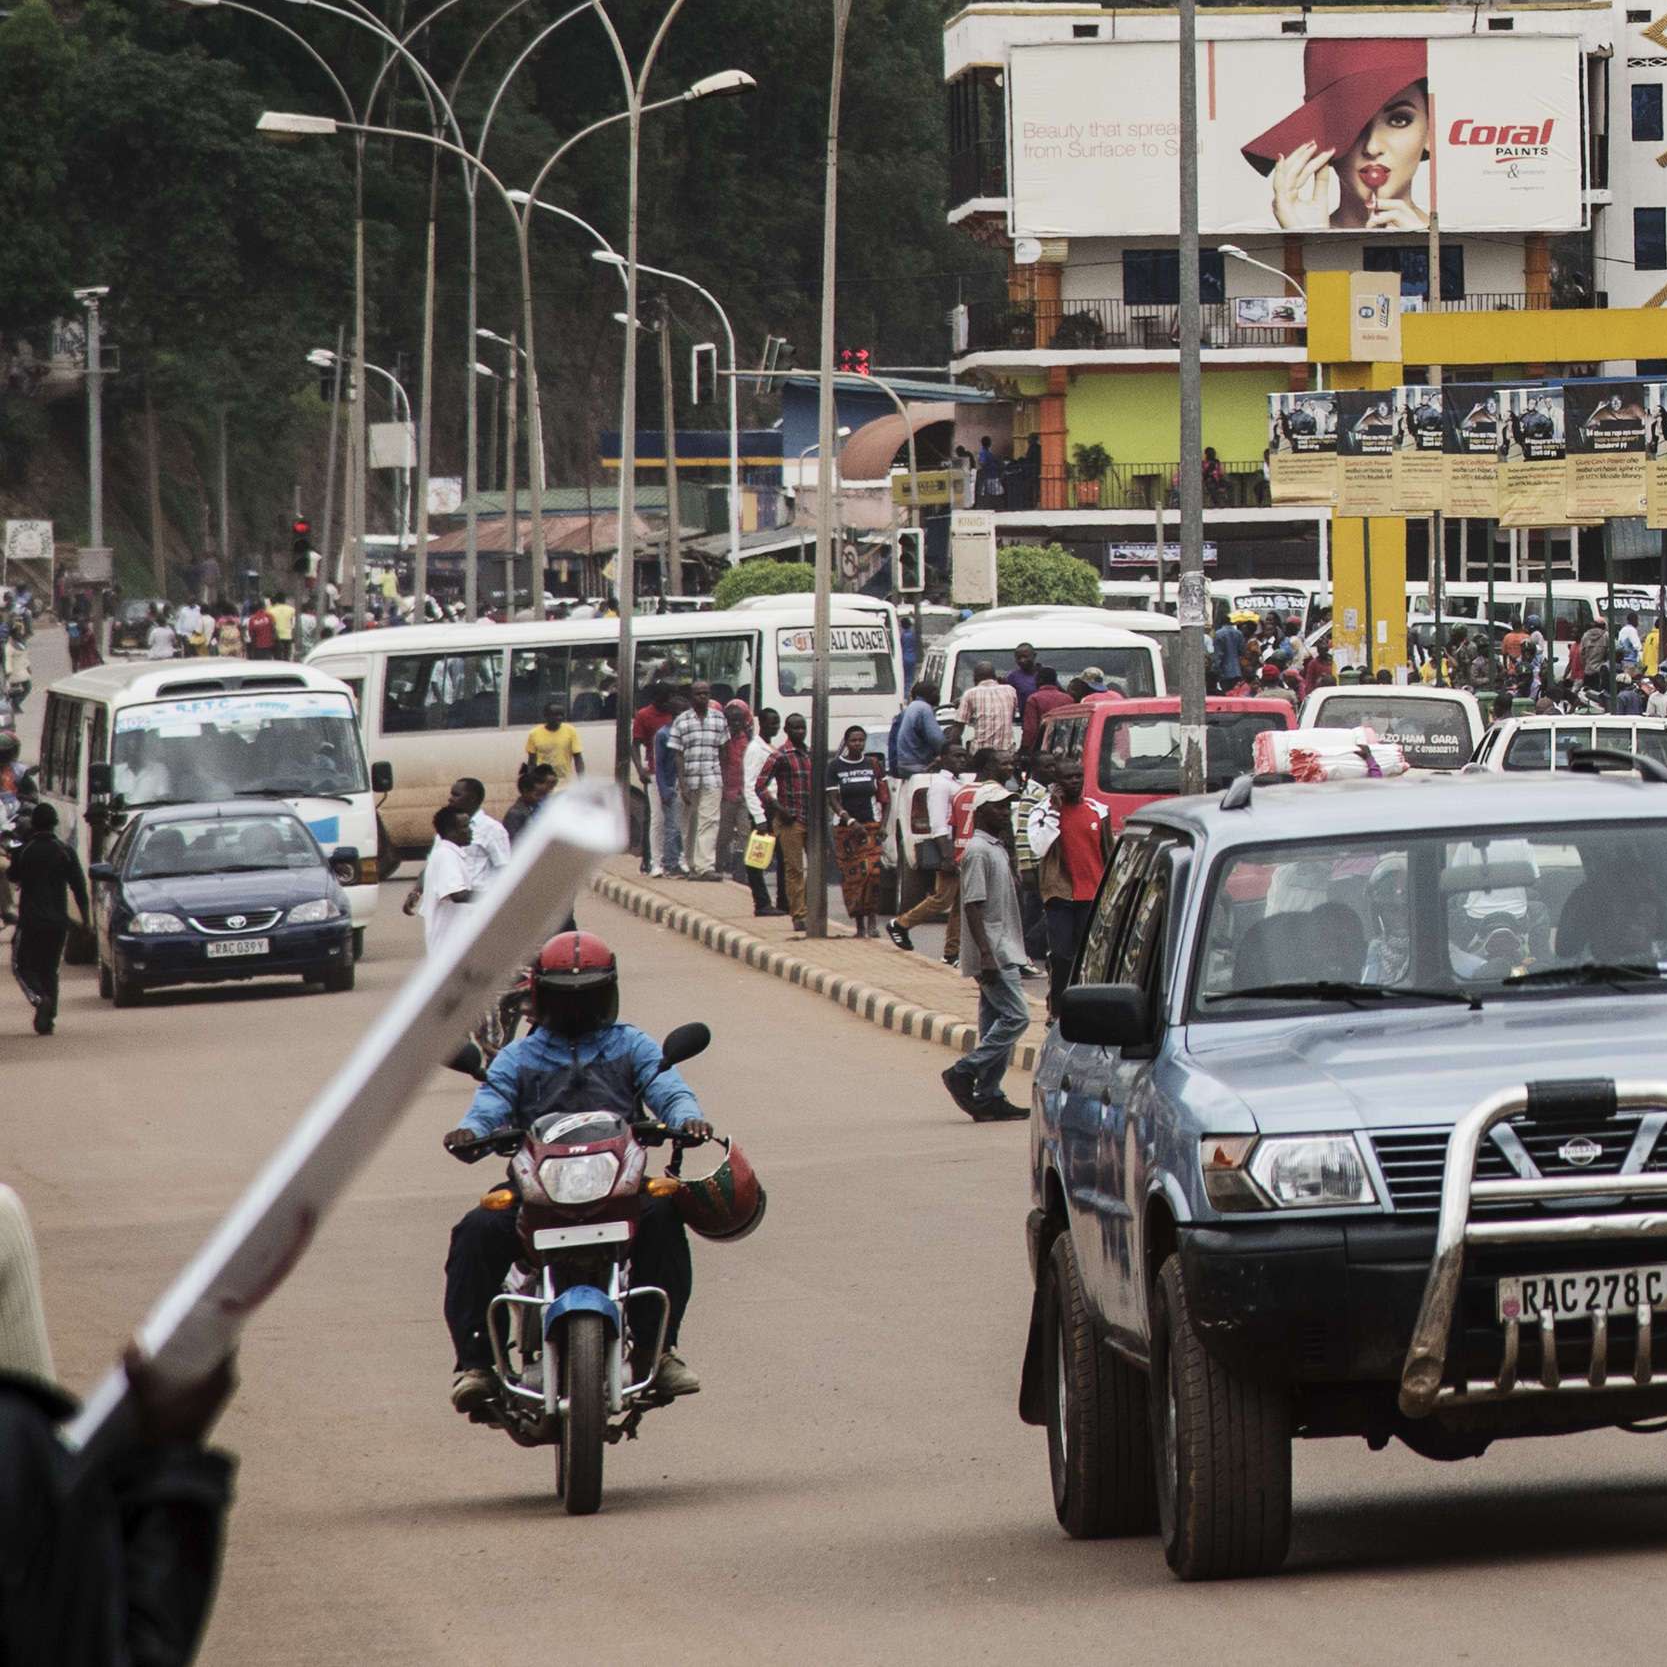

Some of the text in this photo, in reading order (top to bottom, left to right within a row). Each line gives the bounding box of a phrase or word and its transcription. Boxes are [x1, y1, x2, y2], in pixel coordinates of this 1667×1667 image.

[1023, 121, 1084, 140] Beauty
[1089, 121, 1121, 137] that
[1448, 118, 1555, 146] Coral
[1023, 142, 1063, 159] from
[1067, 140, 1136, 159] Surface
[1141, 142, 1157, 157] to
[1495, 147, 1549, 156] PAINTS
[850, 630, 886, 651] COACH
